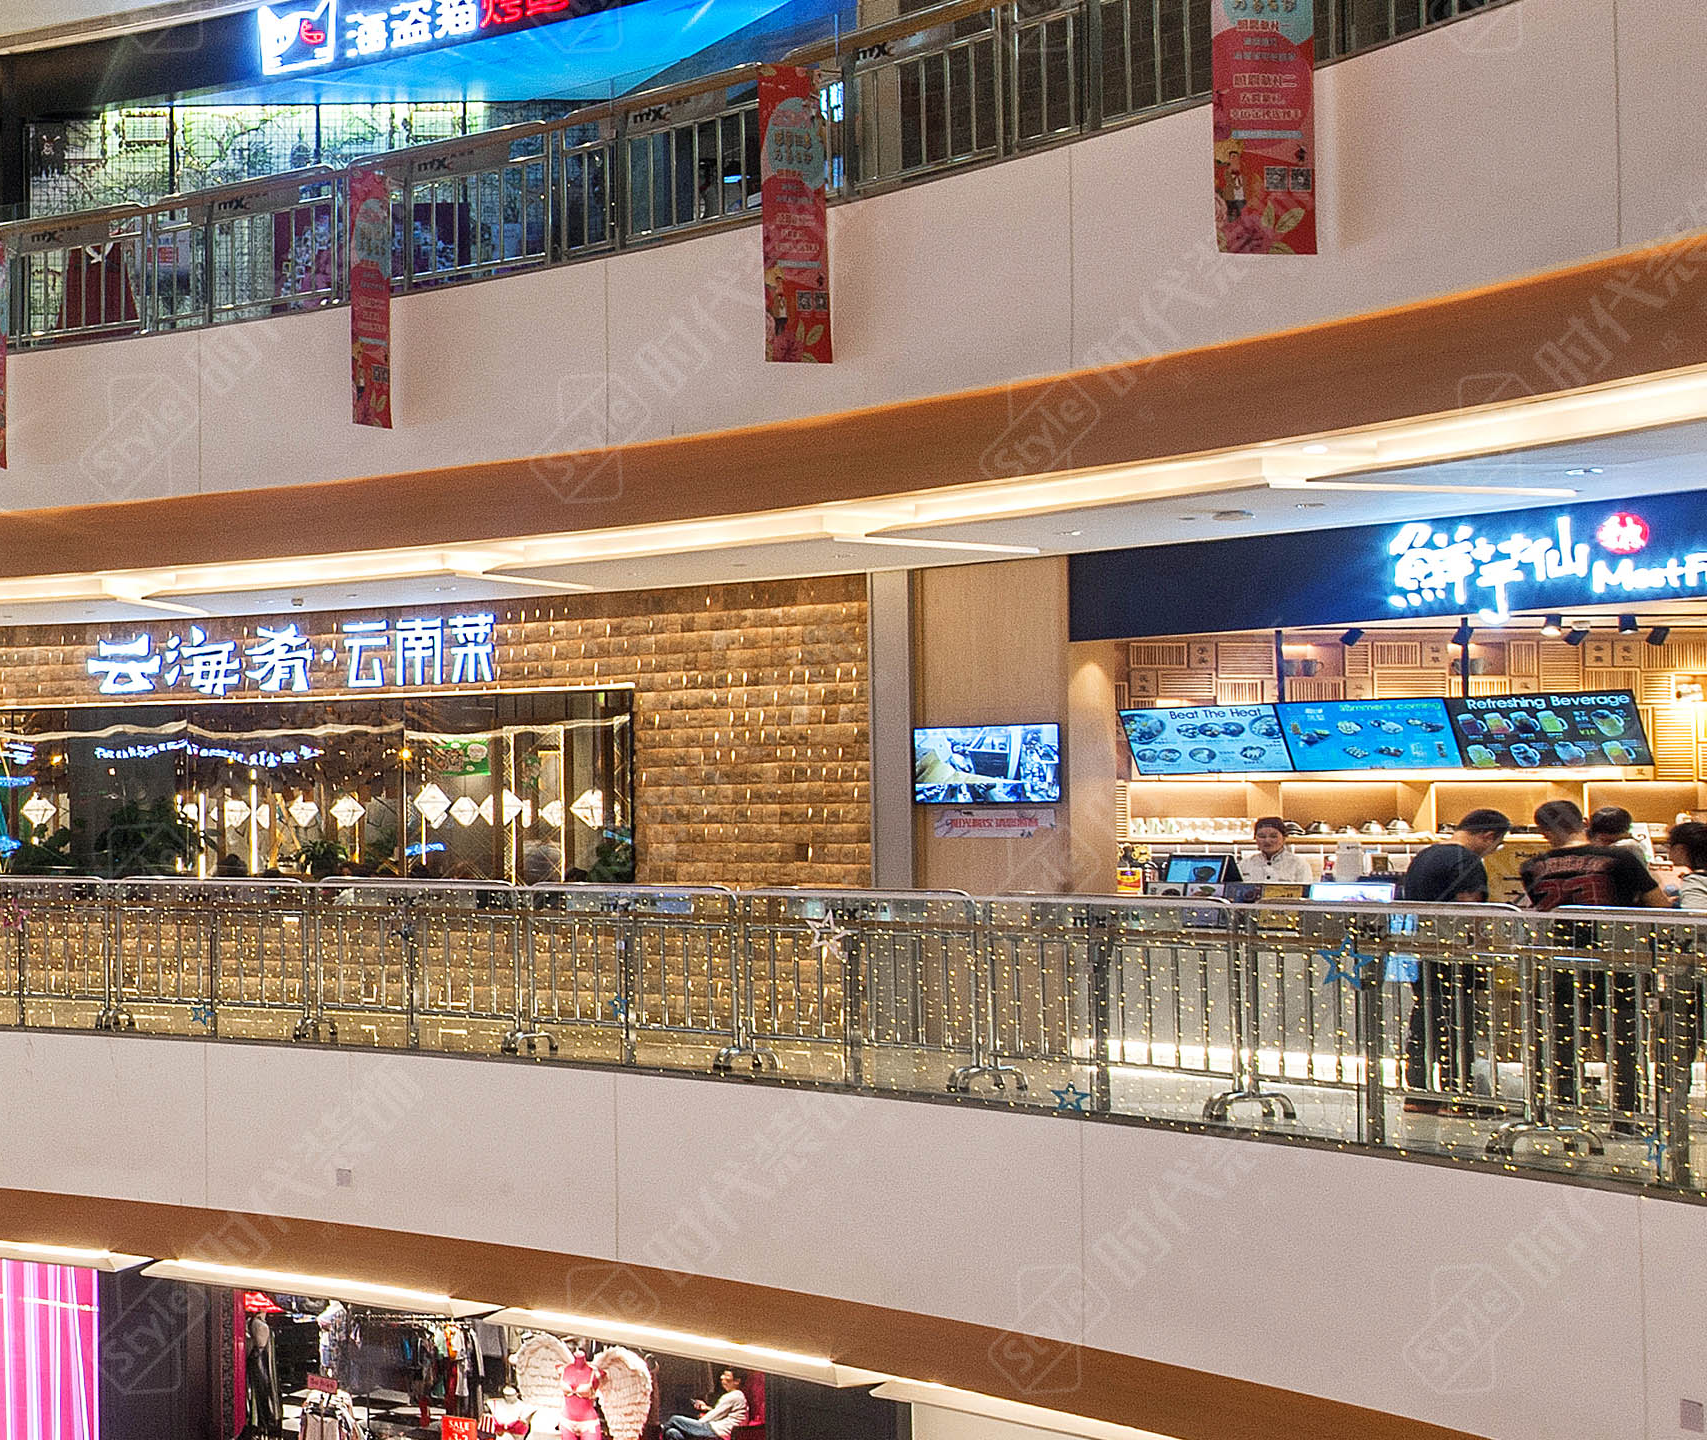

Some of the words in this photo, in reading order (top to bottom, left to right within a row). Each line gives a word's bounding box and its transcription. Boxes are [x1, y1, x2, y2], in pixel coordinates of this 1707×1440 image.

[1465, 693, 1546, 712] Refreshing
[1551, 689, 1631, 709] Beverage
[1169, 709, 1201, 721] Beat
[1204, 708, 1224, 719] The
[1226, 706, 1263, 718] Heat
[448, 1419, 469, 1431] SALE
